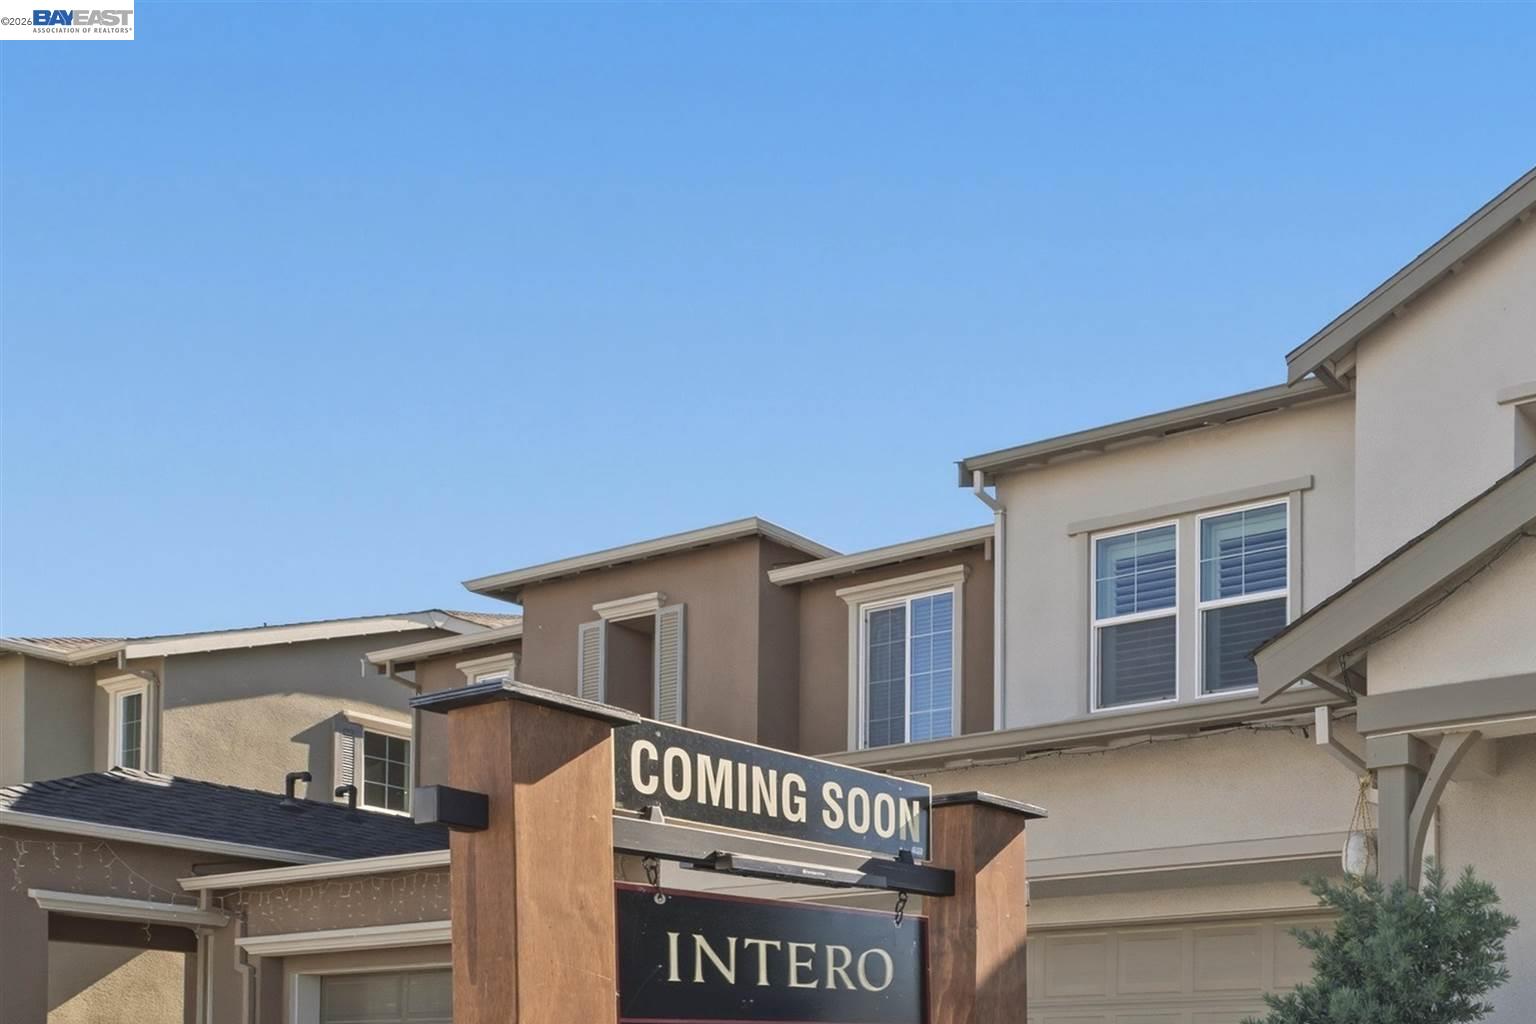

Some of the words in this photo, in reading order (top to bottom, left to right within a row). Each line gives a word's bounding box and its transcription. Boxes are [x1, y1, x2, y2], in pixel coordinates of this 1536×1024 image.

[630, 739, 807, 823] COMING
[821, 781, 921, 843] SOON
[666, 931, 895, 992] INTERO
